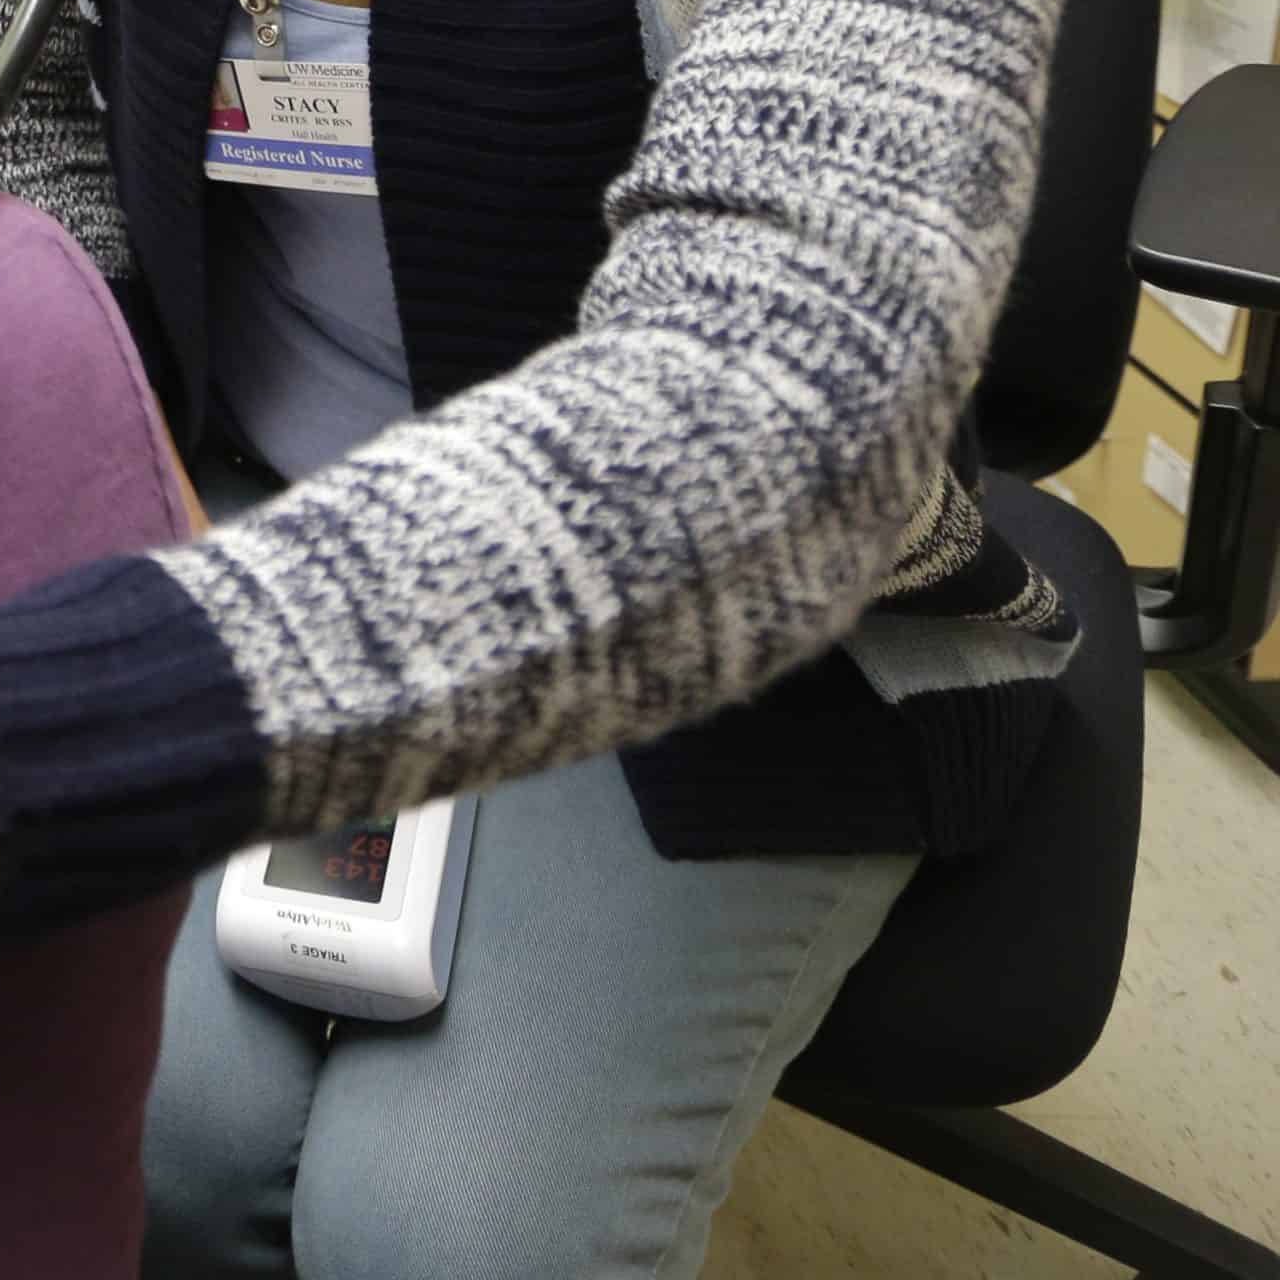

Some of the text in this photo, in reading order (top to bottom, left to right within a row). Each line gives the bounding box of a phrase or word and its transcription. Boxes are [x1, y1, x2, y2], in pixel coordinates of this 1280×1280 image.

[311, 64, 364, 77] Medicine
[273, 96, 340, 114] STACY
[221, 142, 365, 170] Registered Nurse
[290, 943, 348, 964] TRIAGE 3
